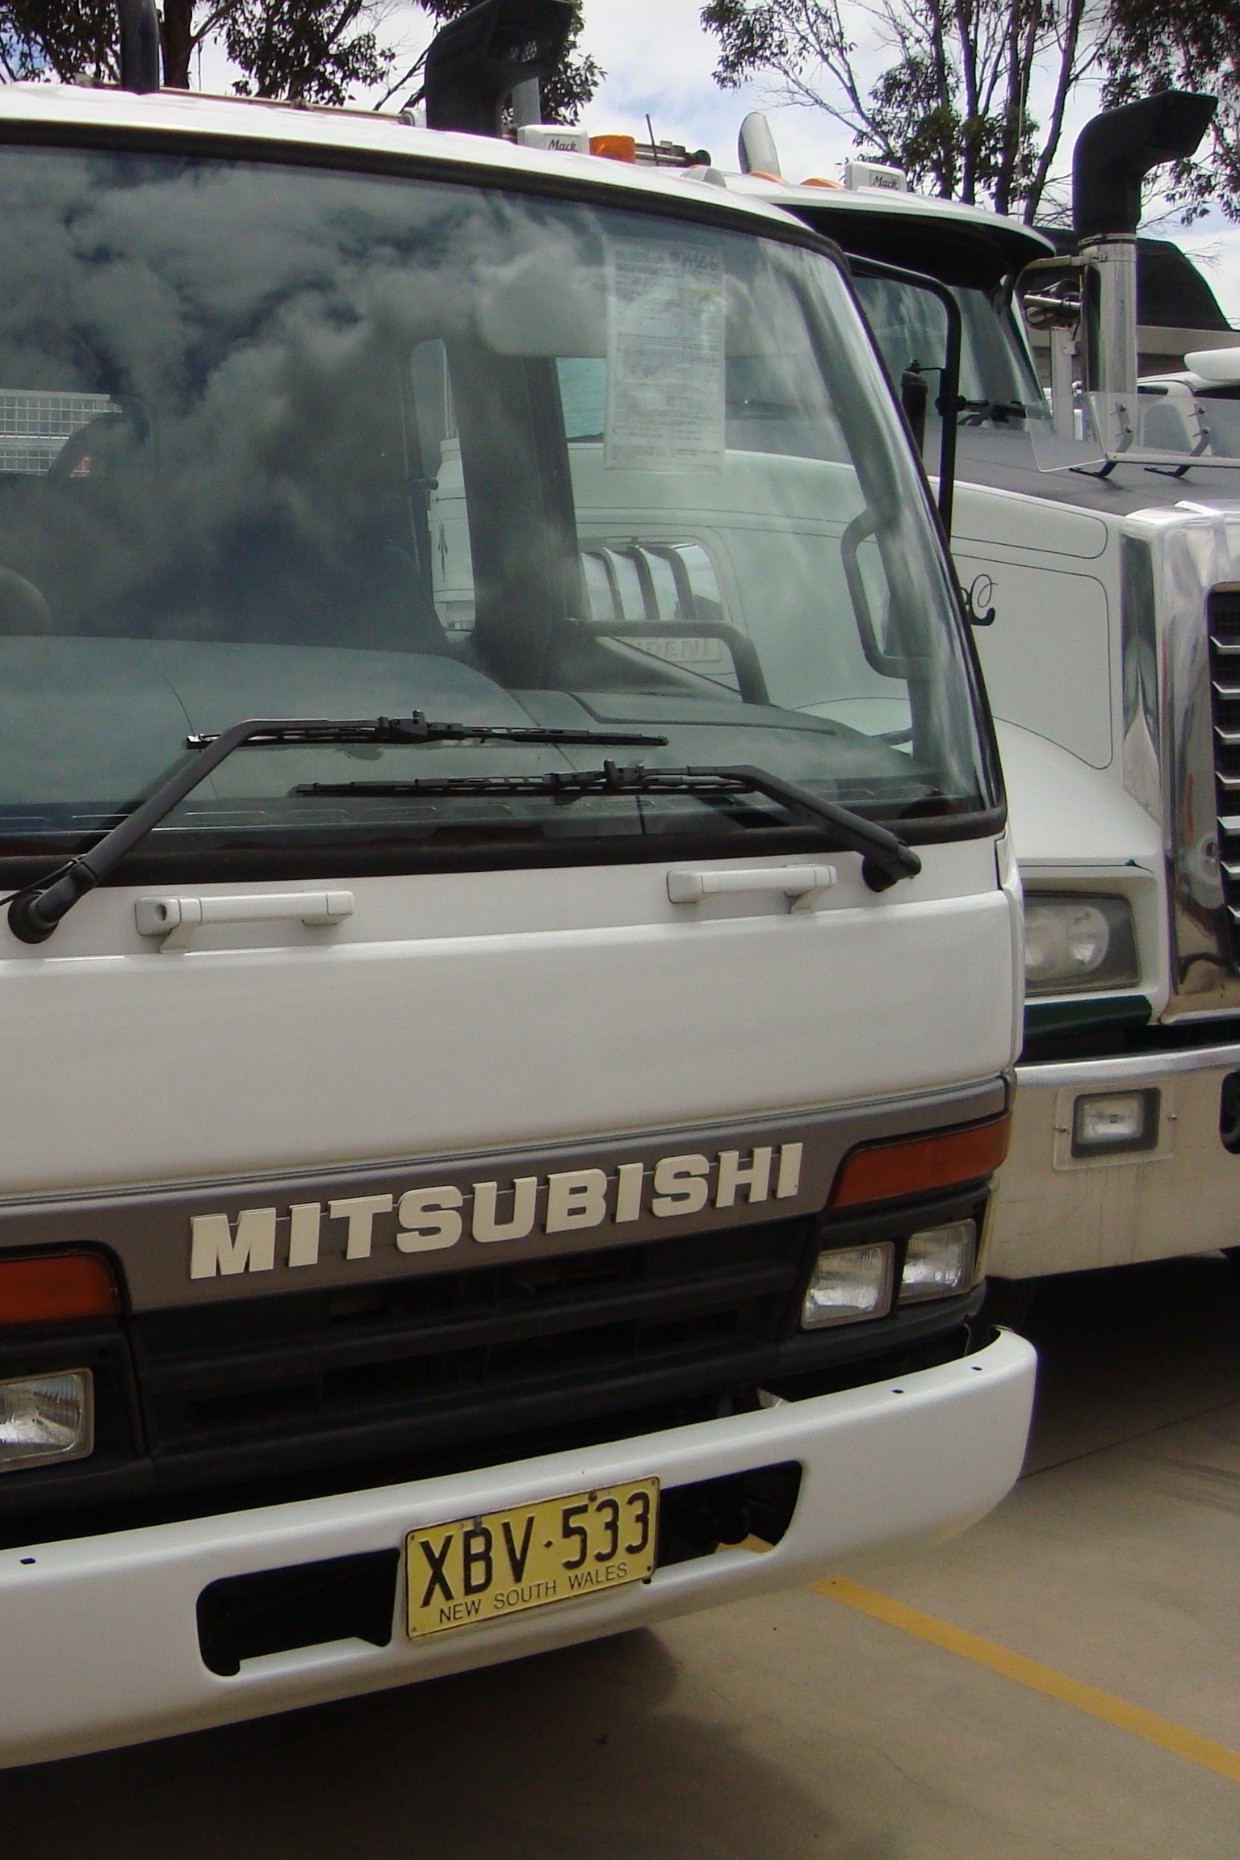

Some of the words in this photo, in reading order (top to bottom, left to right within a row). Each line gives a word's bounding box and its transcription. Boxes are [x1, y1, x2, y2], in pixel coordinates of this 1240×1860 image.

[548, 138, 578, 152] Mack
[872, 175, 899, 191] Mack
[190, 1142, 803, 1280] MITSUBISHI
[439, 1598, 482, 1624] NEW
[494, 1580, 557, 1610] SOUTH
[568, 1562, 628, 1590] WALES
